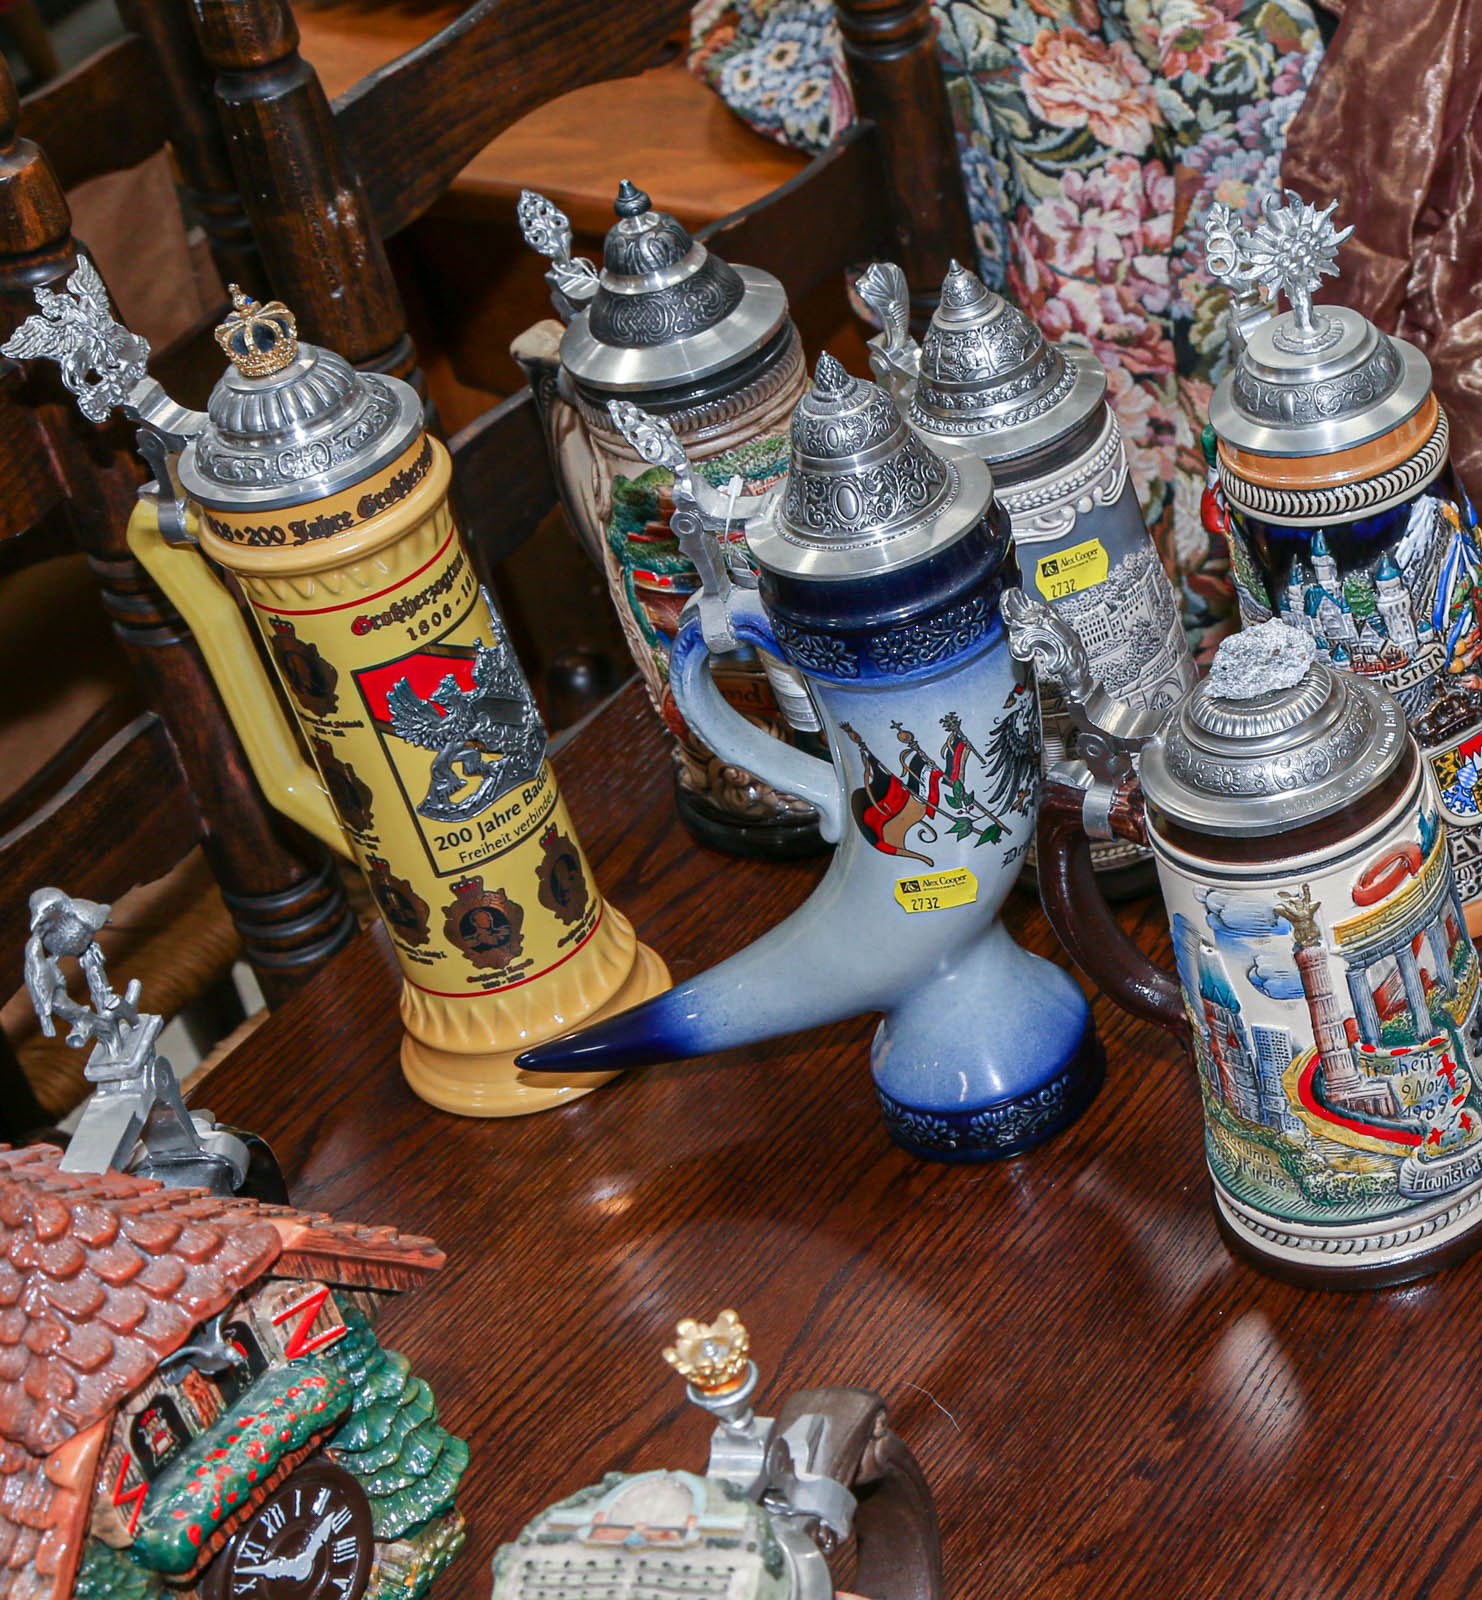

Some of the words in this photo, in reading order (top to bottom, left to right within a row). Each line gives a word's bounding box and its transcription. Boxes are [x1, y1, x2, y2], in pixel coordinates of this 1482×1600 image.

[1050, 578, 1077, 599] 2732
[405, 602, 454, 641] 1806
[433, 827, 473, 852] 200
[476, 803, 522, 841] Jahre
[458, 832, 513, 864] Freiheit
[922, 878, 939, 888] Alex
[939, 873, 968, 887] Cooper
[911, 897, 941, 912] 2732
[1401, 1093, 1450, 1122] 1989
